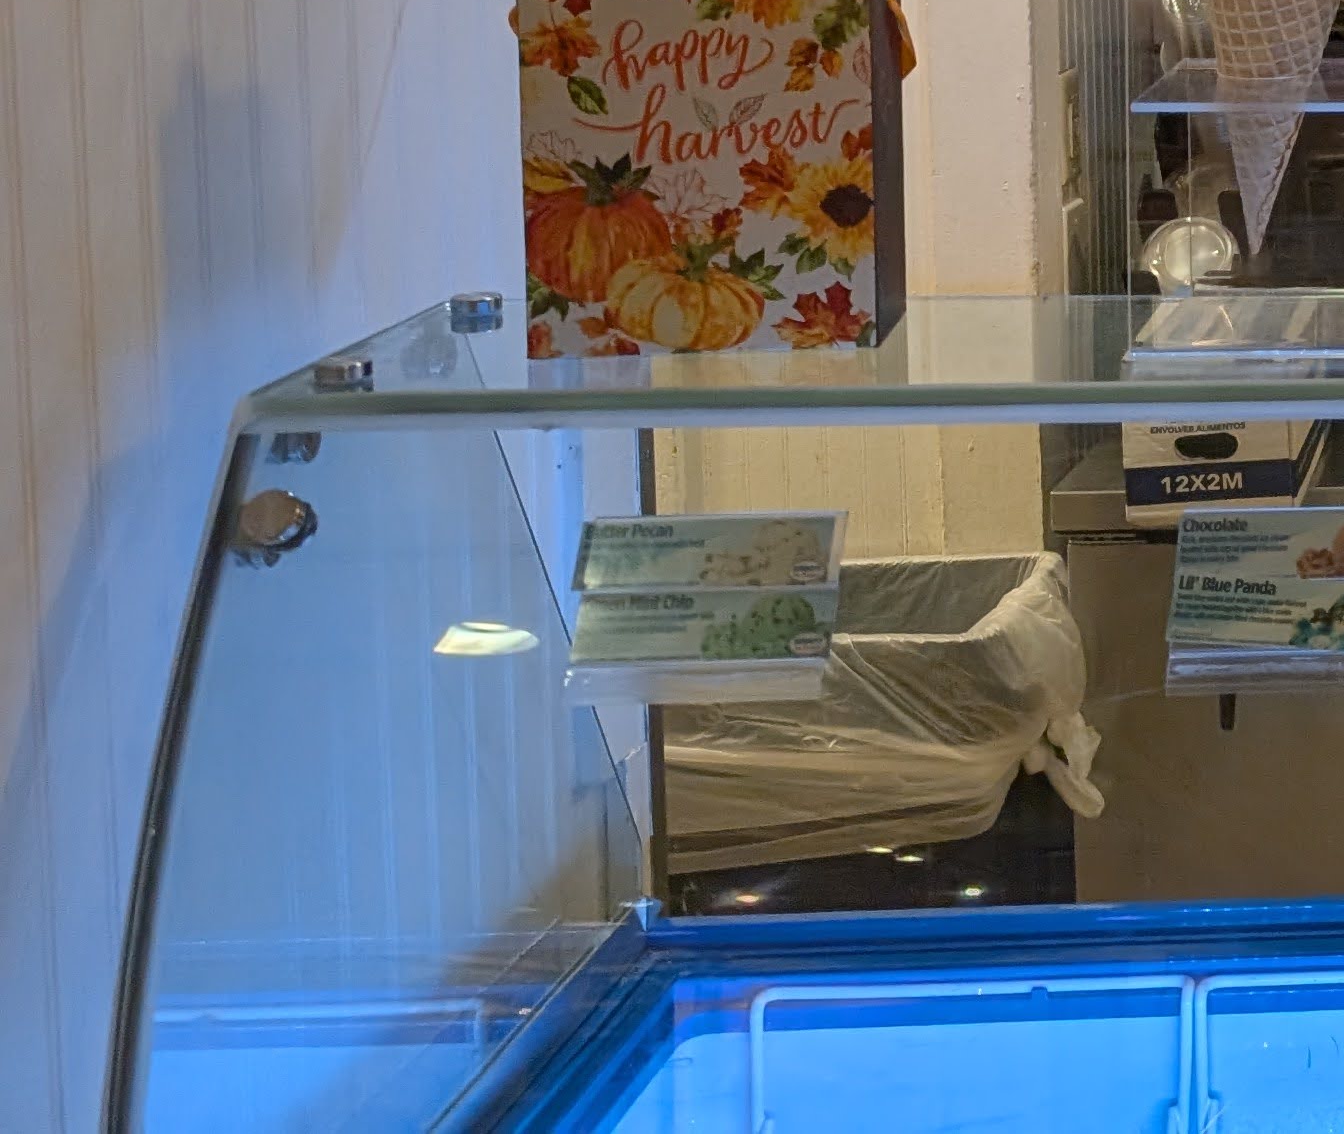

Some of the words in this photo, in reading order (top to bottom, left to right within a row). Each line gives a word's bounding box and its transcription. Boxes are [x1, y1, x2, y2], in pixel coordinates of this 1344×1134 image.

[602, 19, 775, 91] happy
[573, 83, 860, 164] harvest
[1160, 471, 1244, 495] 12X2M
[632, 523, 675, 539] Pecan
[1183, 517, 1248, 533] Chocolate
[1201, 576, 1232, 594] Blue
[1233, 577, 1277, 596] Panda
